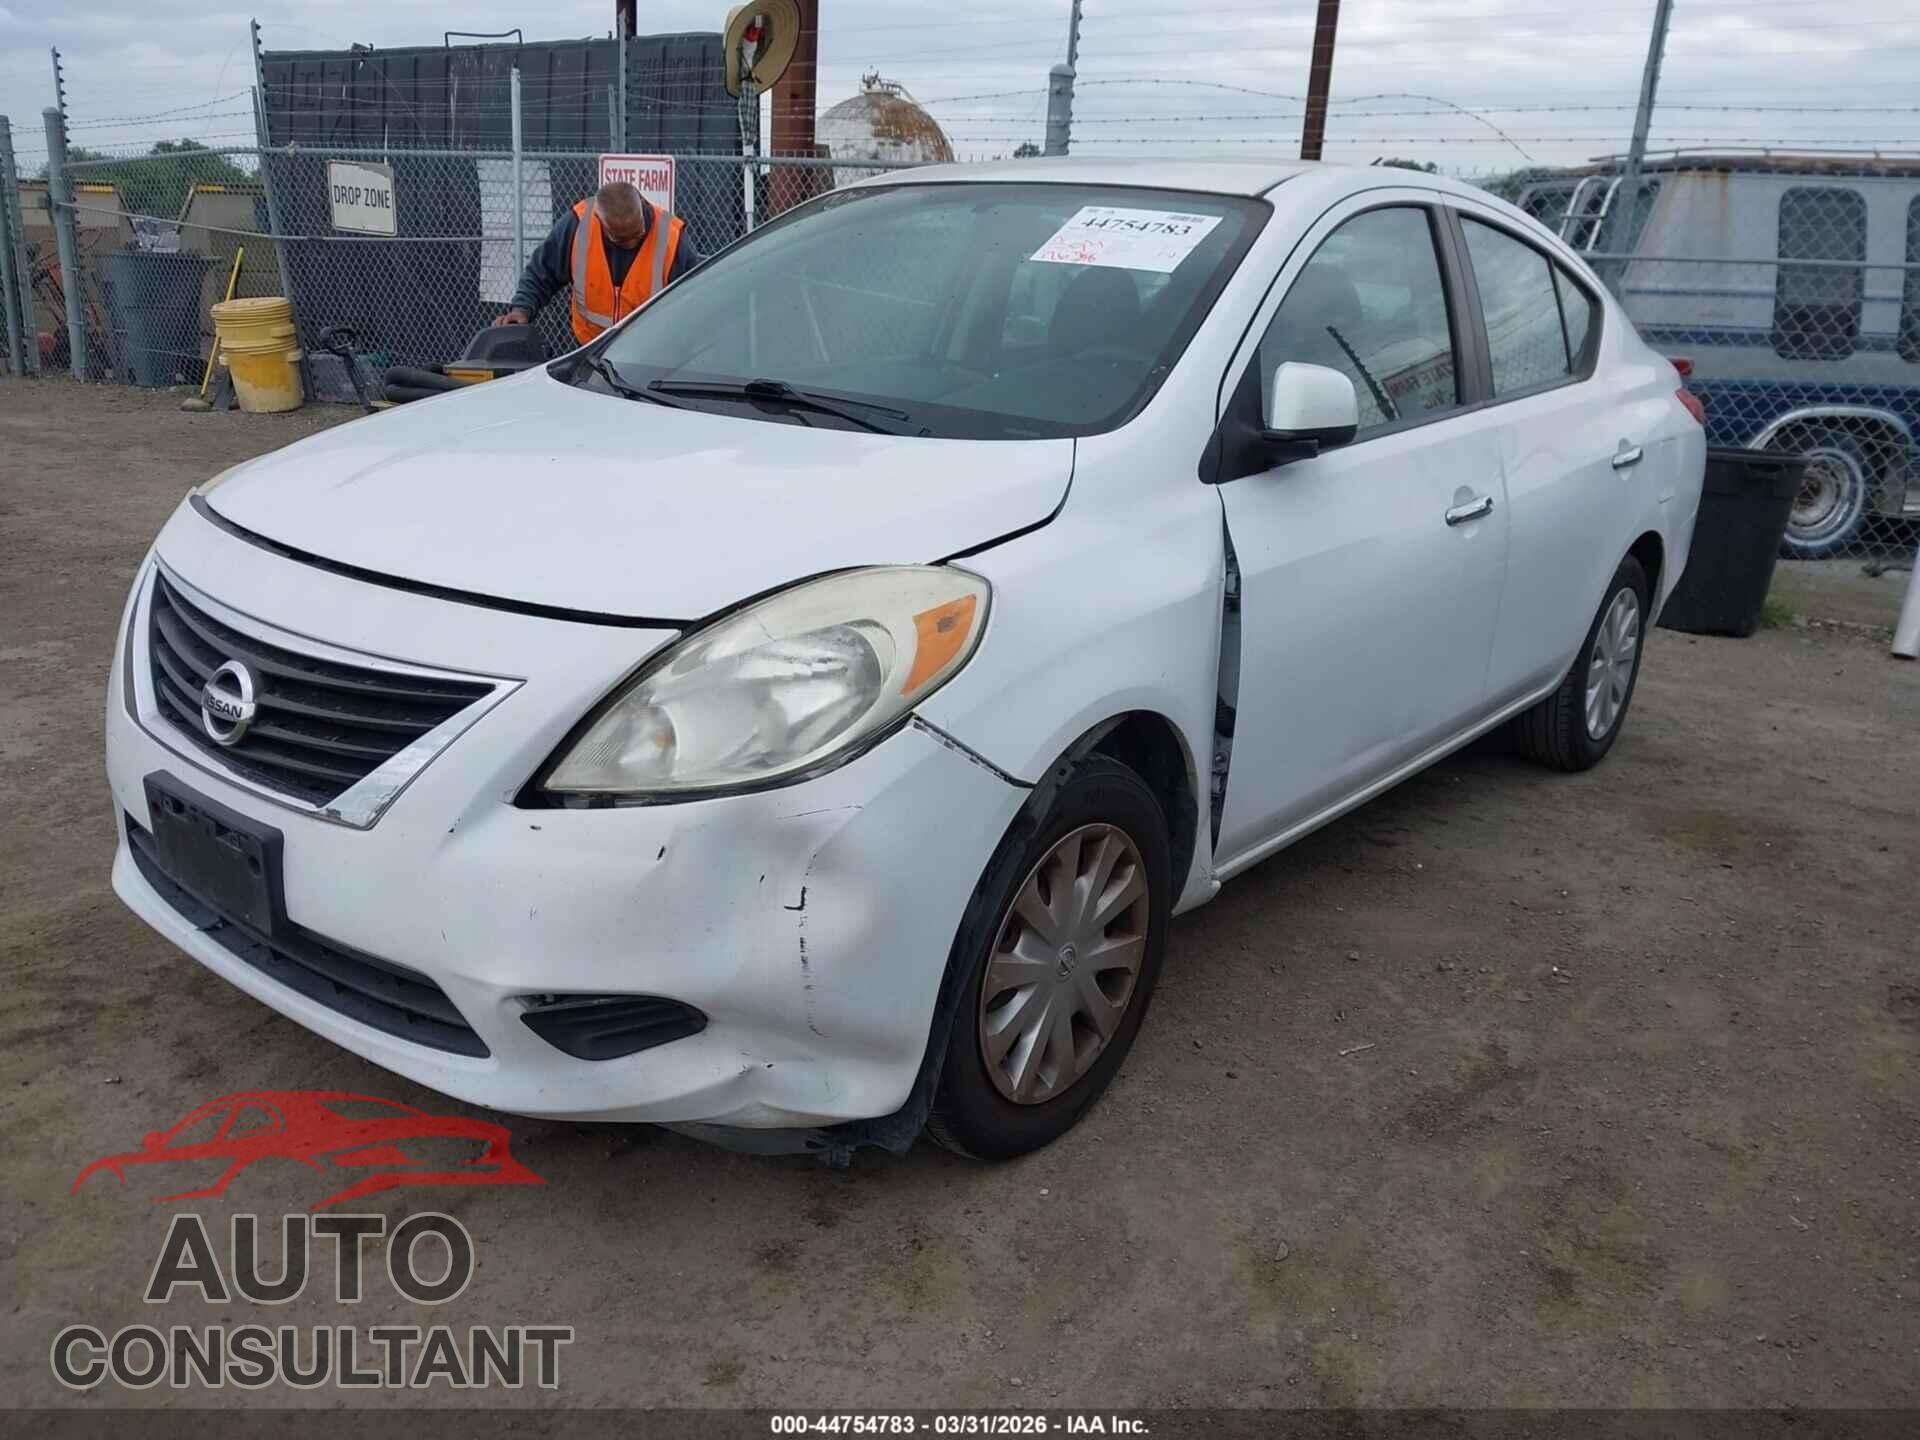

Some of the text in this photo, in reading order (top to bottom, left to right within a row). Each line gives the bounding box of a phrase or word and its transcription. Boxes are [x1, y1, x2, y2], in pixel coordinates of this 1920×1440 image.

[605, 167, 669, 192] STATE FARM
[333, 184, 391, 209] DROP ZONE
[1081, 216, 1193, 236] 44754783
